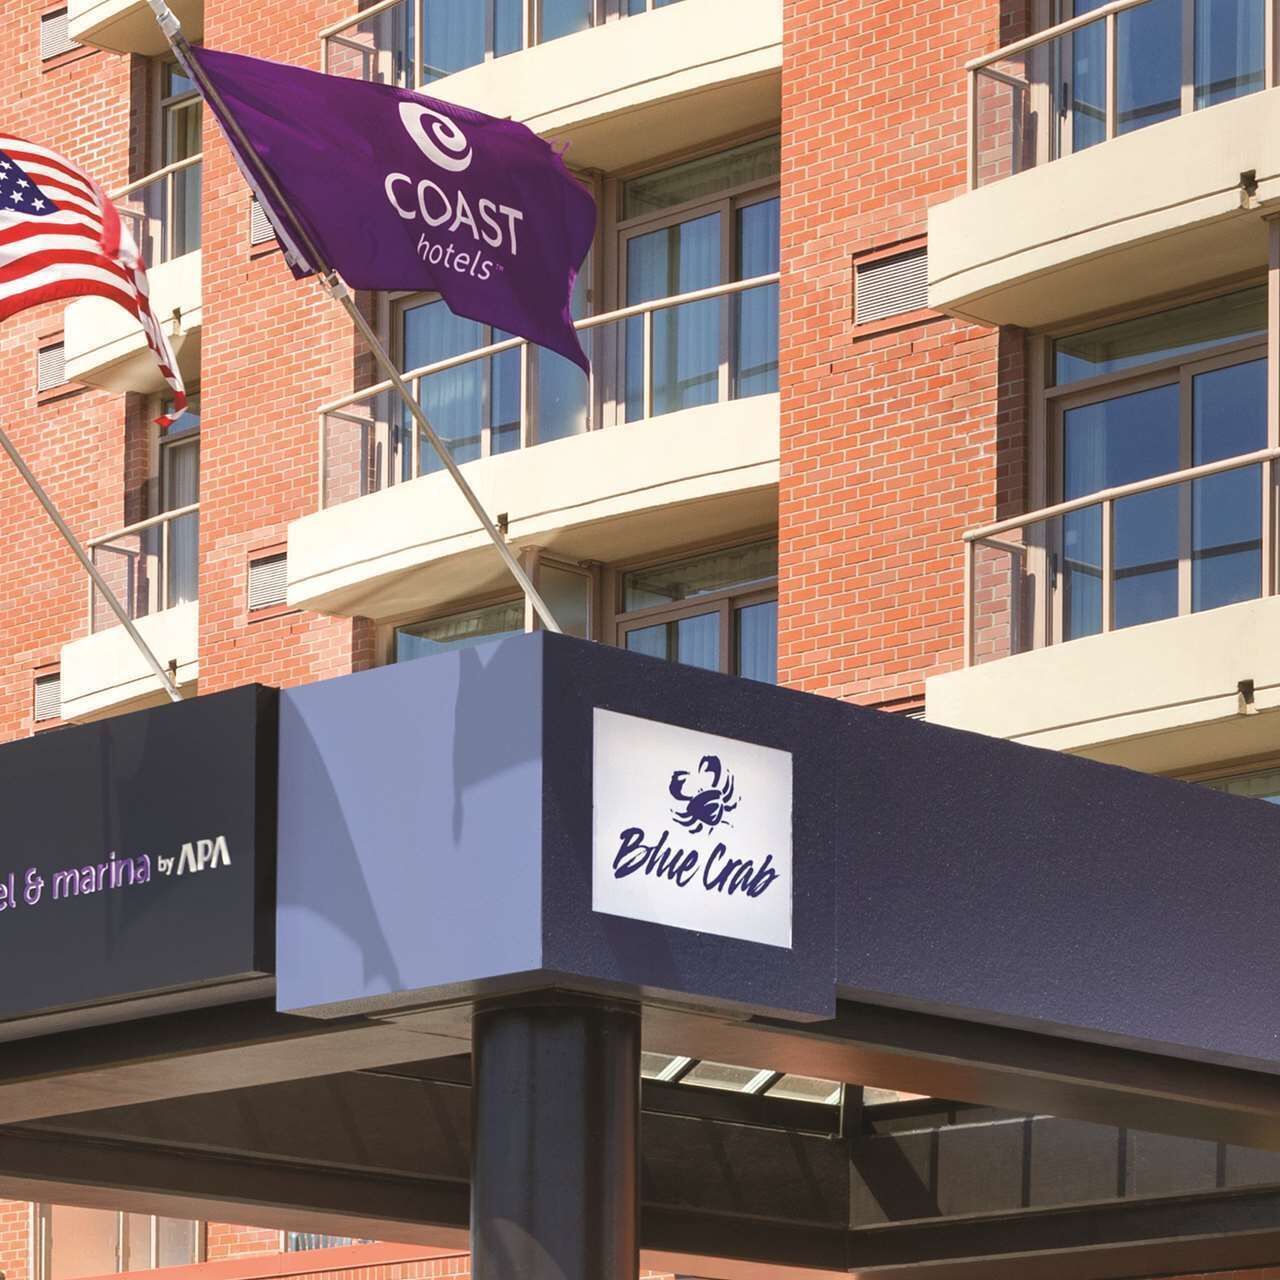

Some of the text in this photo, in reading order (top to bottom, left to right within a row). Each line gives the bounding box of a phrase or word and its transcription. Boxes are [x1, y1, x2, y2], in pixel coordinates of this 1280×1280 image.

[384, 172, 523, 256] COAST
[417, 233, 493, 280] hotels
[23, 867, 44, 905] &
[52, 851, 151, 900] marina
[157, 855, 176, 875] by
[176, 835, 232, 876] APA
[612, 827, 781, 898] Blue Crab
